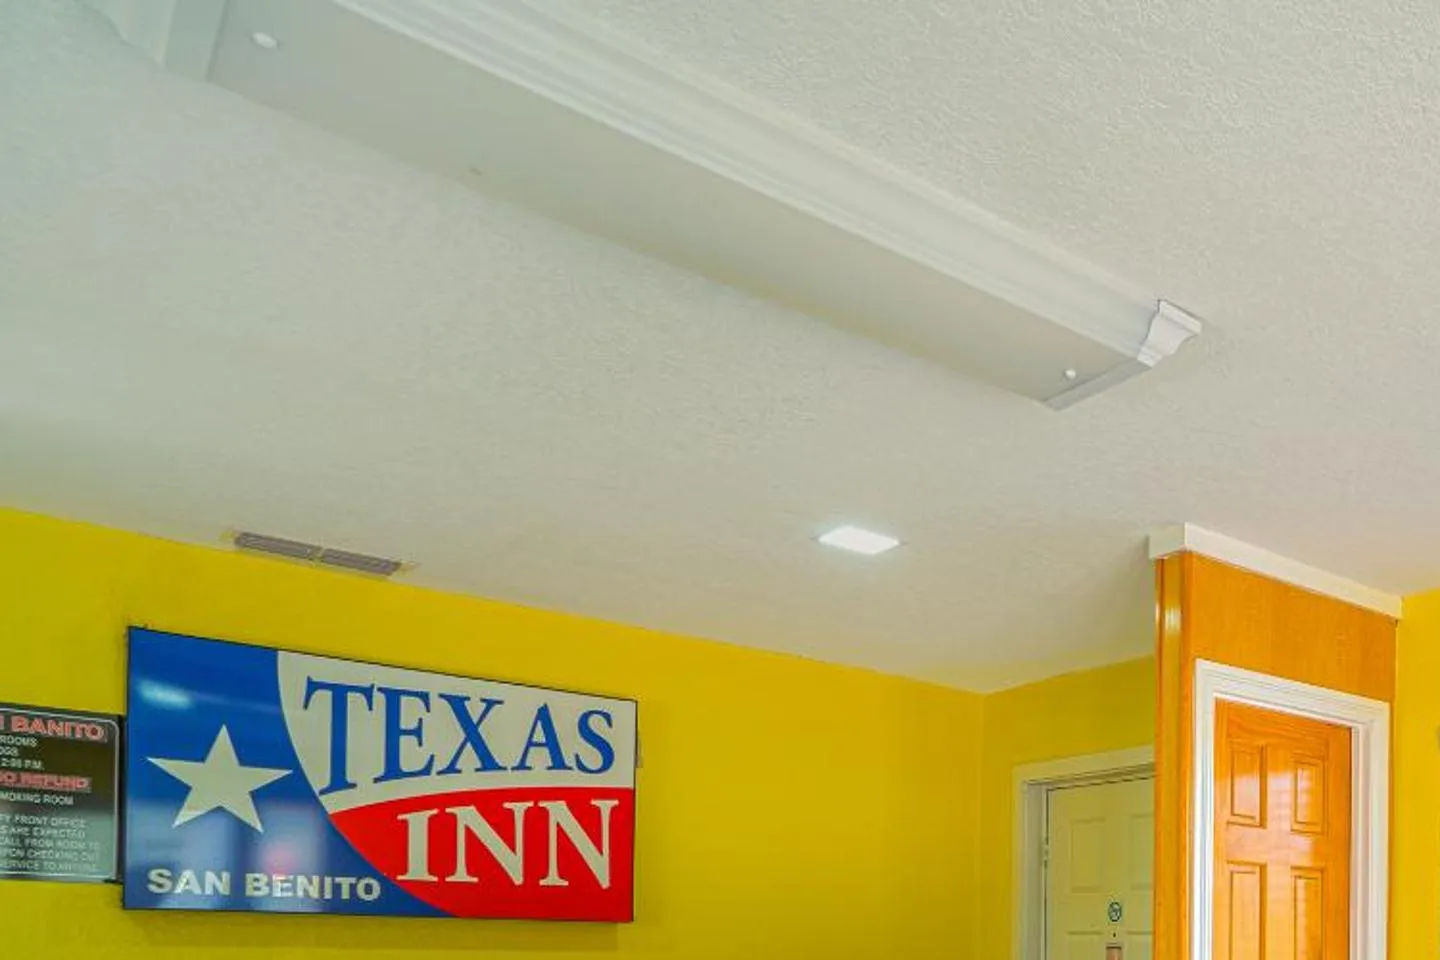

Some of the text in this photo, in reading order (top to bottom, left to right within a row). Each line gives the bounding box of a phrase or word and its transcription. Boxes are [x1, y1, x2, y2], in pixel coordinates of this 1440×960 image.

[11, 715, 106, 741] BANITO
[302, 675, 615, 796] TEXAS
[0, 791, 74, 805] MOKING ROOM
[397, 799, 619, 889] INN
[148, 868, 381, 901] SAN BENITO
